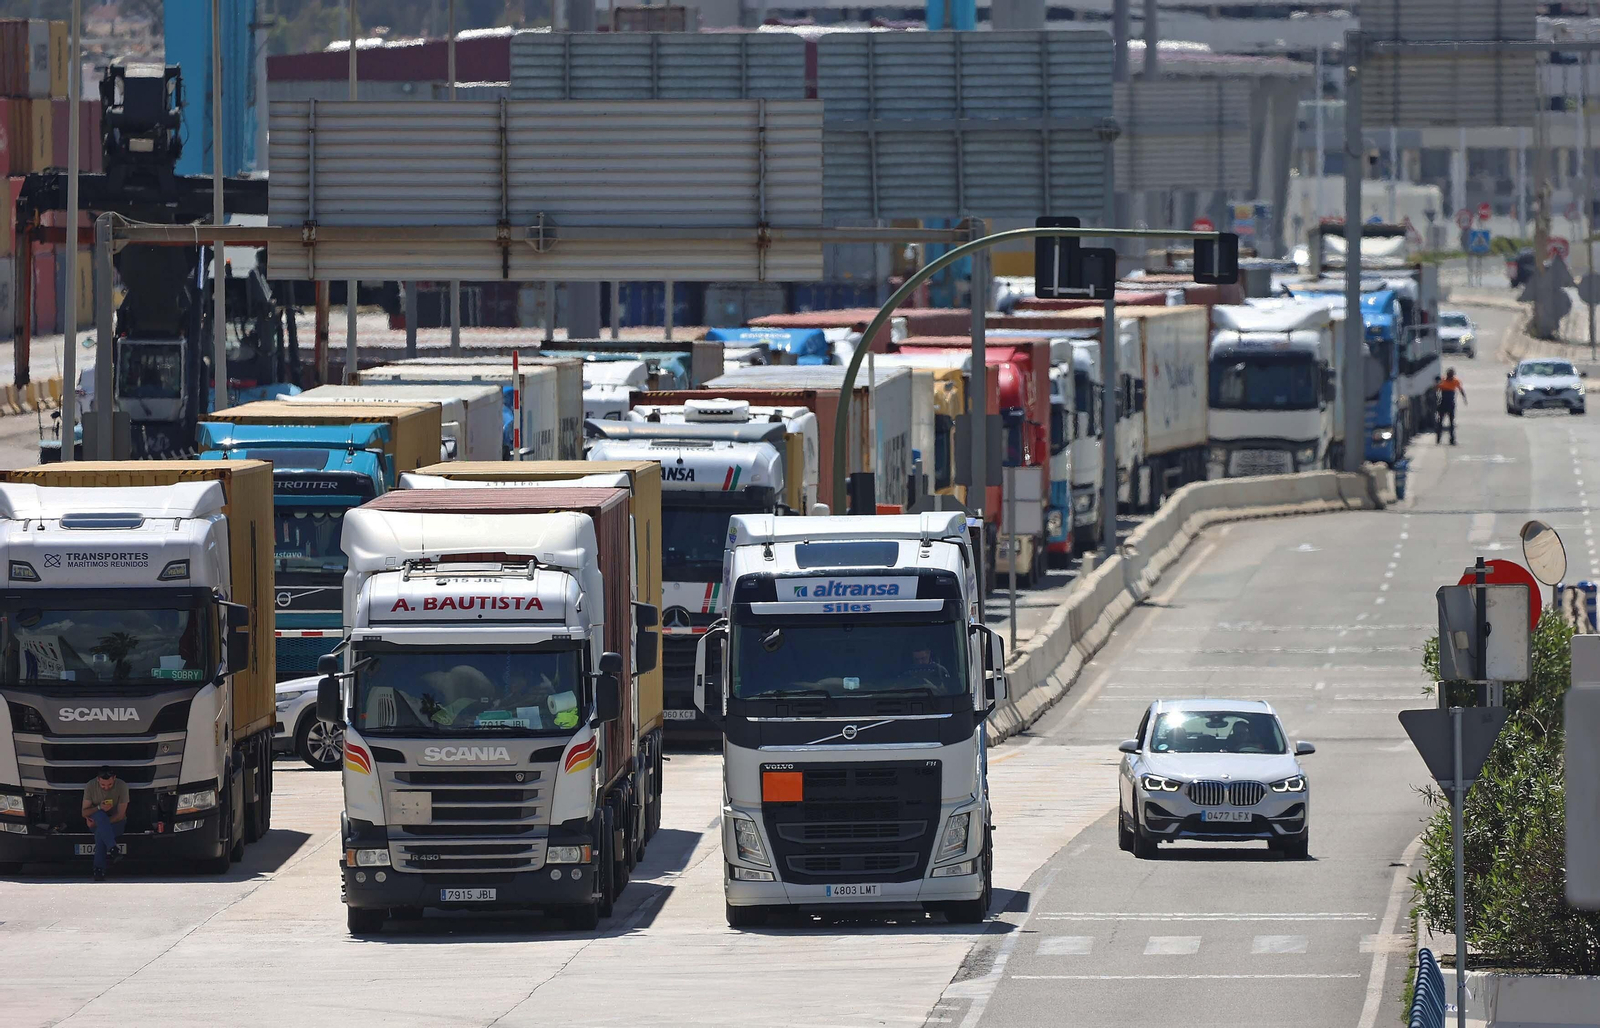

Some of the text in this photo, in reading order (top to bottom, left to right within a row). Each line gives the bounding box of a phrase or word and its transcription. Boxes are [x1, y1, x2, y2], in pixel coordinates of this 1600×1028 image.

[275, 480, 338, 489] TROTTER
[66, 552, 149, 561] TRANSPORTES
[67, 560, 149, 568] MARÍTIMOS REUNIDOS
[813, 580, 900, 598] altransa
[390, 596, 544, 612] A. BAUTISTA
[822, 602, 872, 613] Siles
[58, 707, 140, 721] SCANIA
[423, 746, 511, 761] SCANIA
[1207, 812, 1230, 820] 0477
[448, 890, 494, 899] 7915 JBL
[833, 885, 877, 895] 4803 LMT
